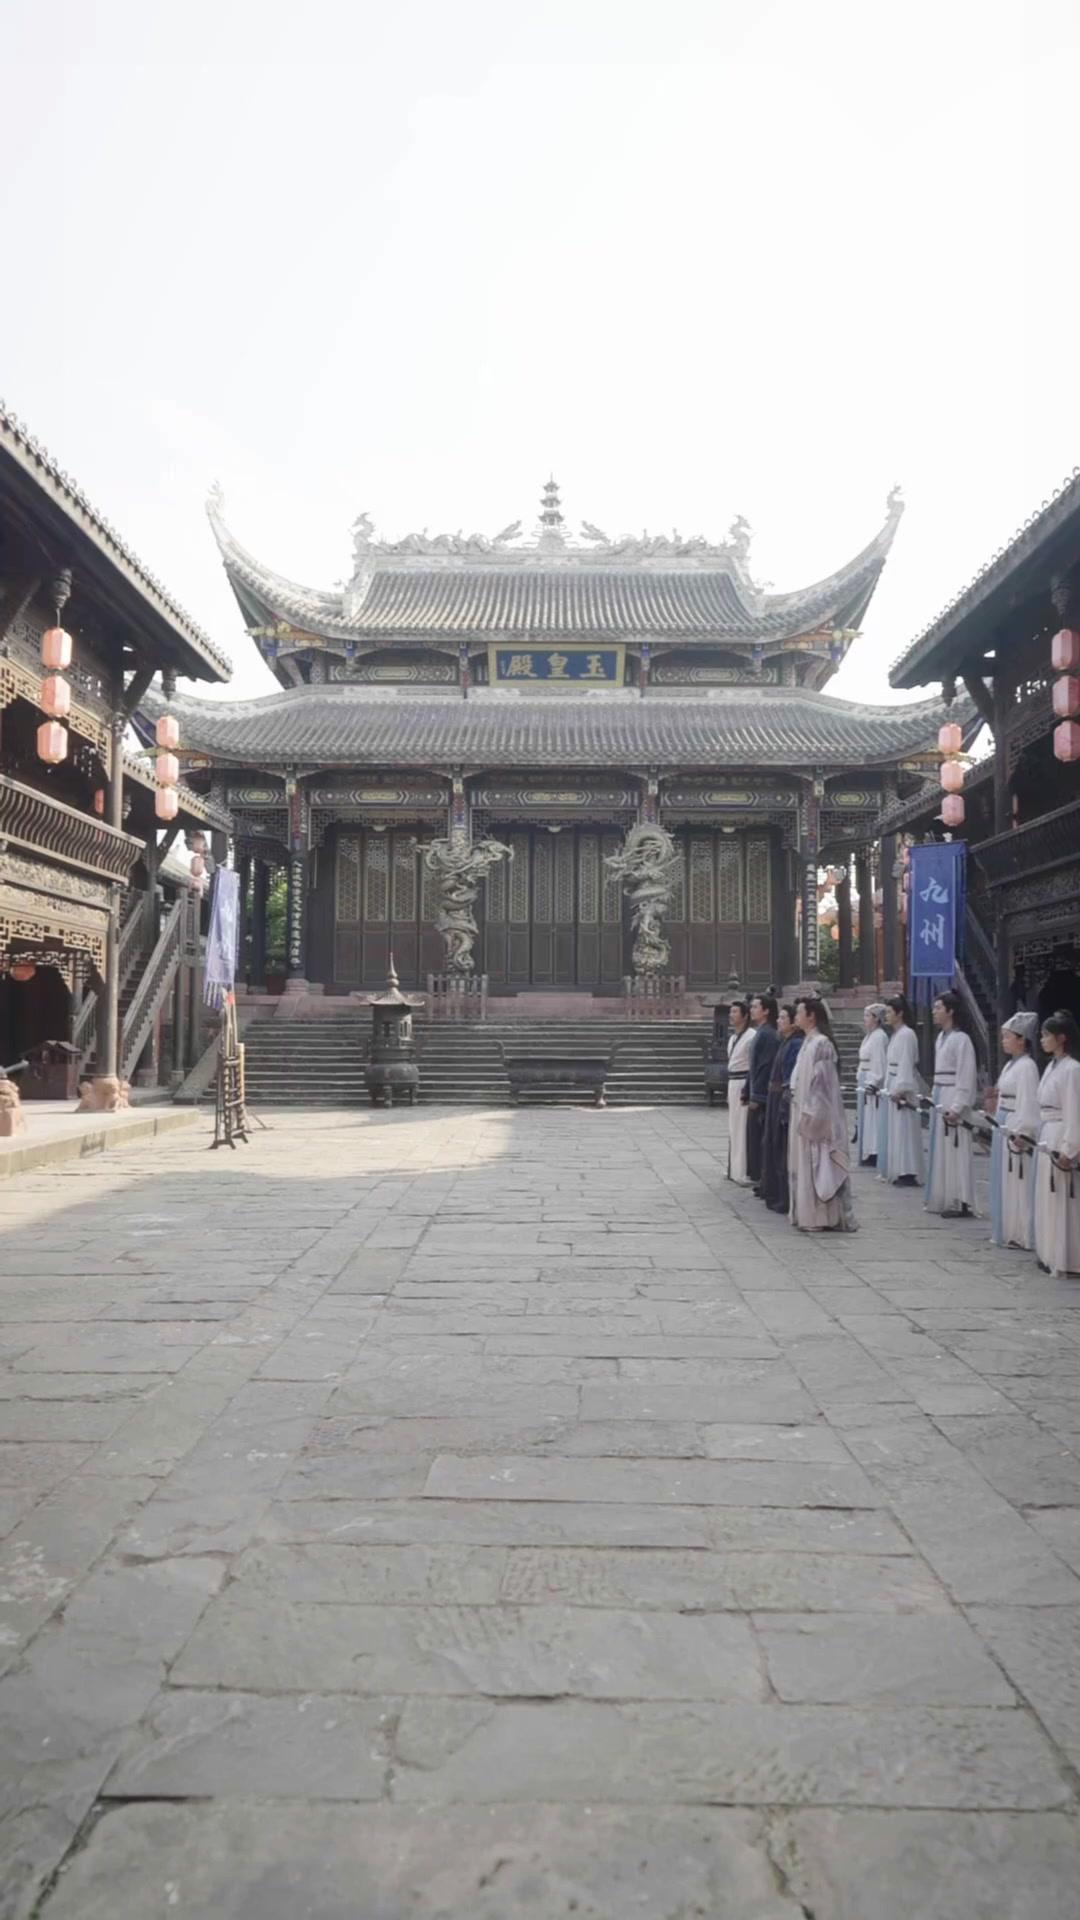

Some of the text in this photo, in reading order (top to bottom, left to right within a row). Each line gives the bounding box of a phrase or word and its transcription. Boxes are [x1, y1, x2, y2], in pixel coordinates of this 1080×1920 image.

[505, 652, 607, 678] 玉皇殿
[919, 876, 949, 950] 九州
